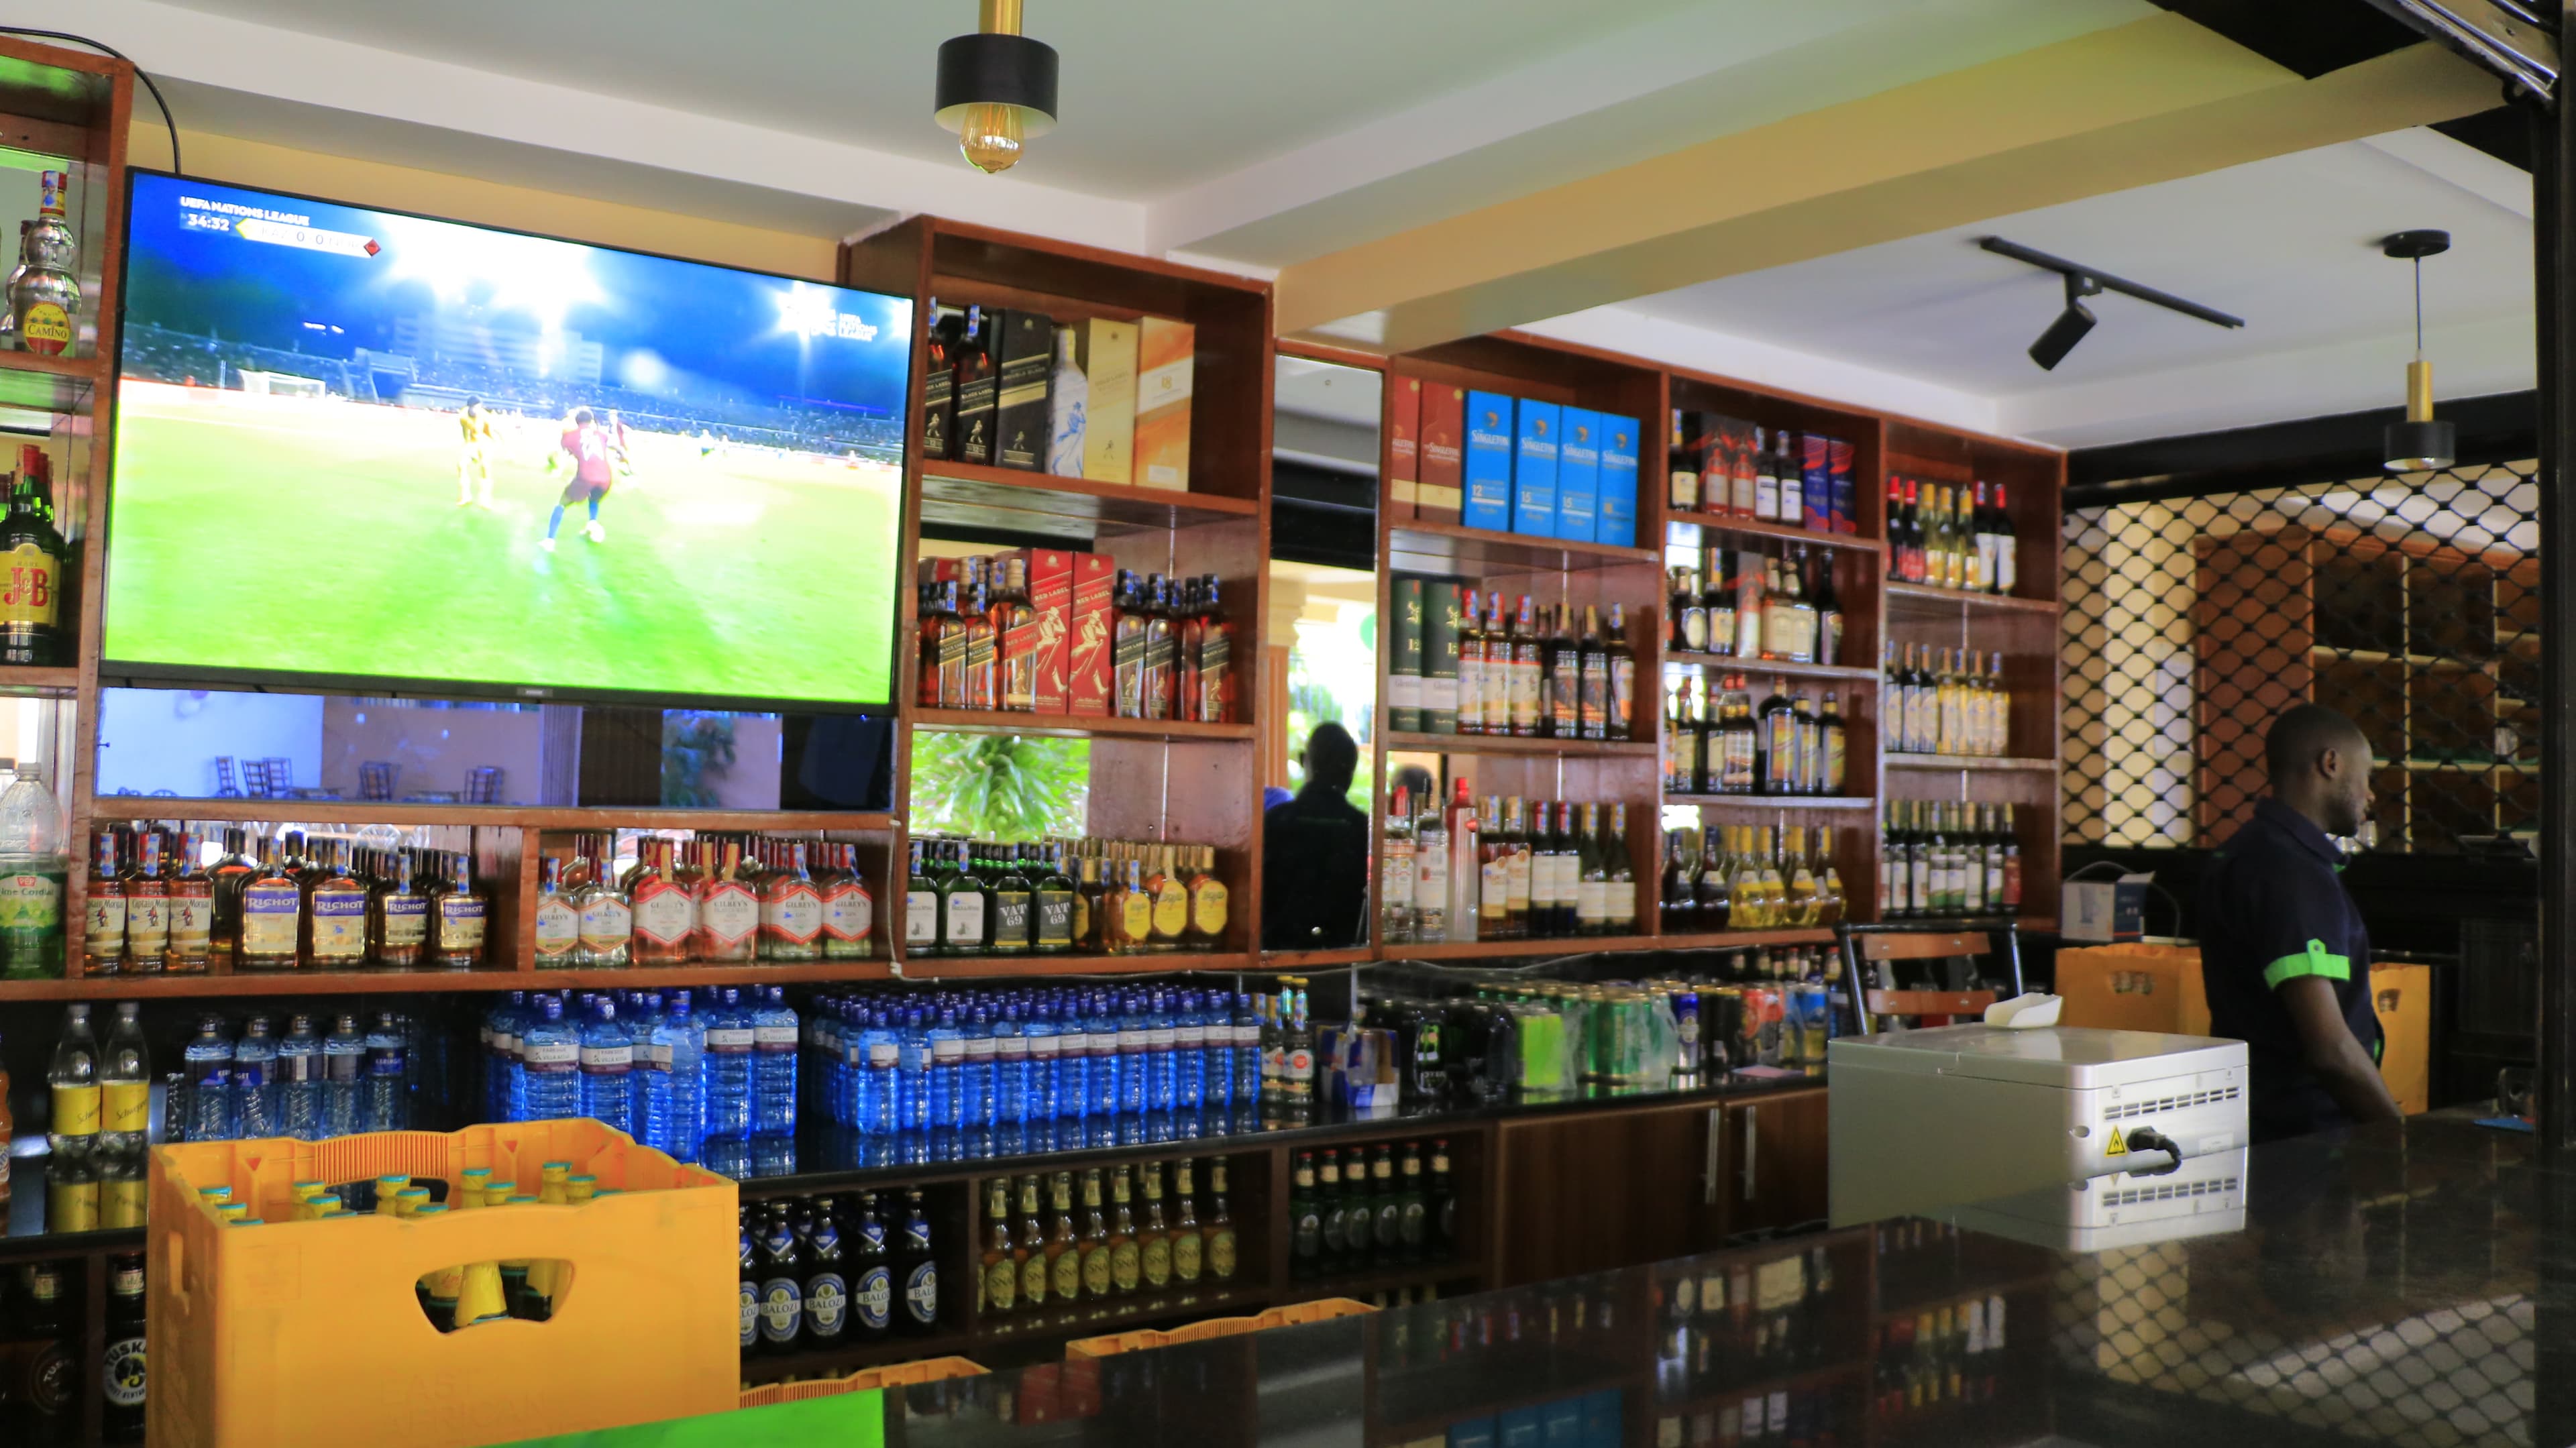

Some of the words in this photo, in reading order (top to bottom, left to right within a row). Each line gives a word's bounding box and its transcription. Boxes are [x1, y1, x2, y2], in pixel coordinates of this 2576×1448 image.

[180, 196, 211, 212] UEFA
[211, 201, 264, 219] NATIONS
[264, 209, 311, 226] LEAGUE
[188, 213, 229, 231] 34:32
[1472, 484, 1483, 496] 12
[1034, 593, 1047, 602] RED
[1048, 586, 1069, 597] LABEL
[1076, 596, 1089, 604] RED
[1090, 590, 1111, 600] LABEL
[0, 887, 18, 895] ime
[21, 887, 54, 896] Cordial
[247, 897, 299, 909] RICHOT
[315, 900, 366, 912] RICHOT
[389, 902, 427, 913] RICHOT
[1044, 902, 1071, 915] VAT
[445, 905, 484, 914] RICHOT
[1000, 903, 1027, 917] VAT
[1007, 915, 1024, 926] 69
[1050, 913, 1066, 925] 69
[762, 1302, 798, 1315] BALOZI
[808, 1298, 843, 1309] BALOZI
